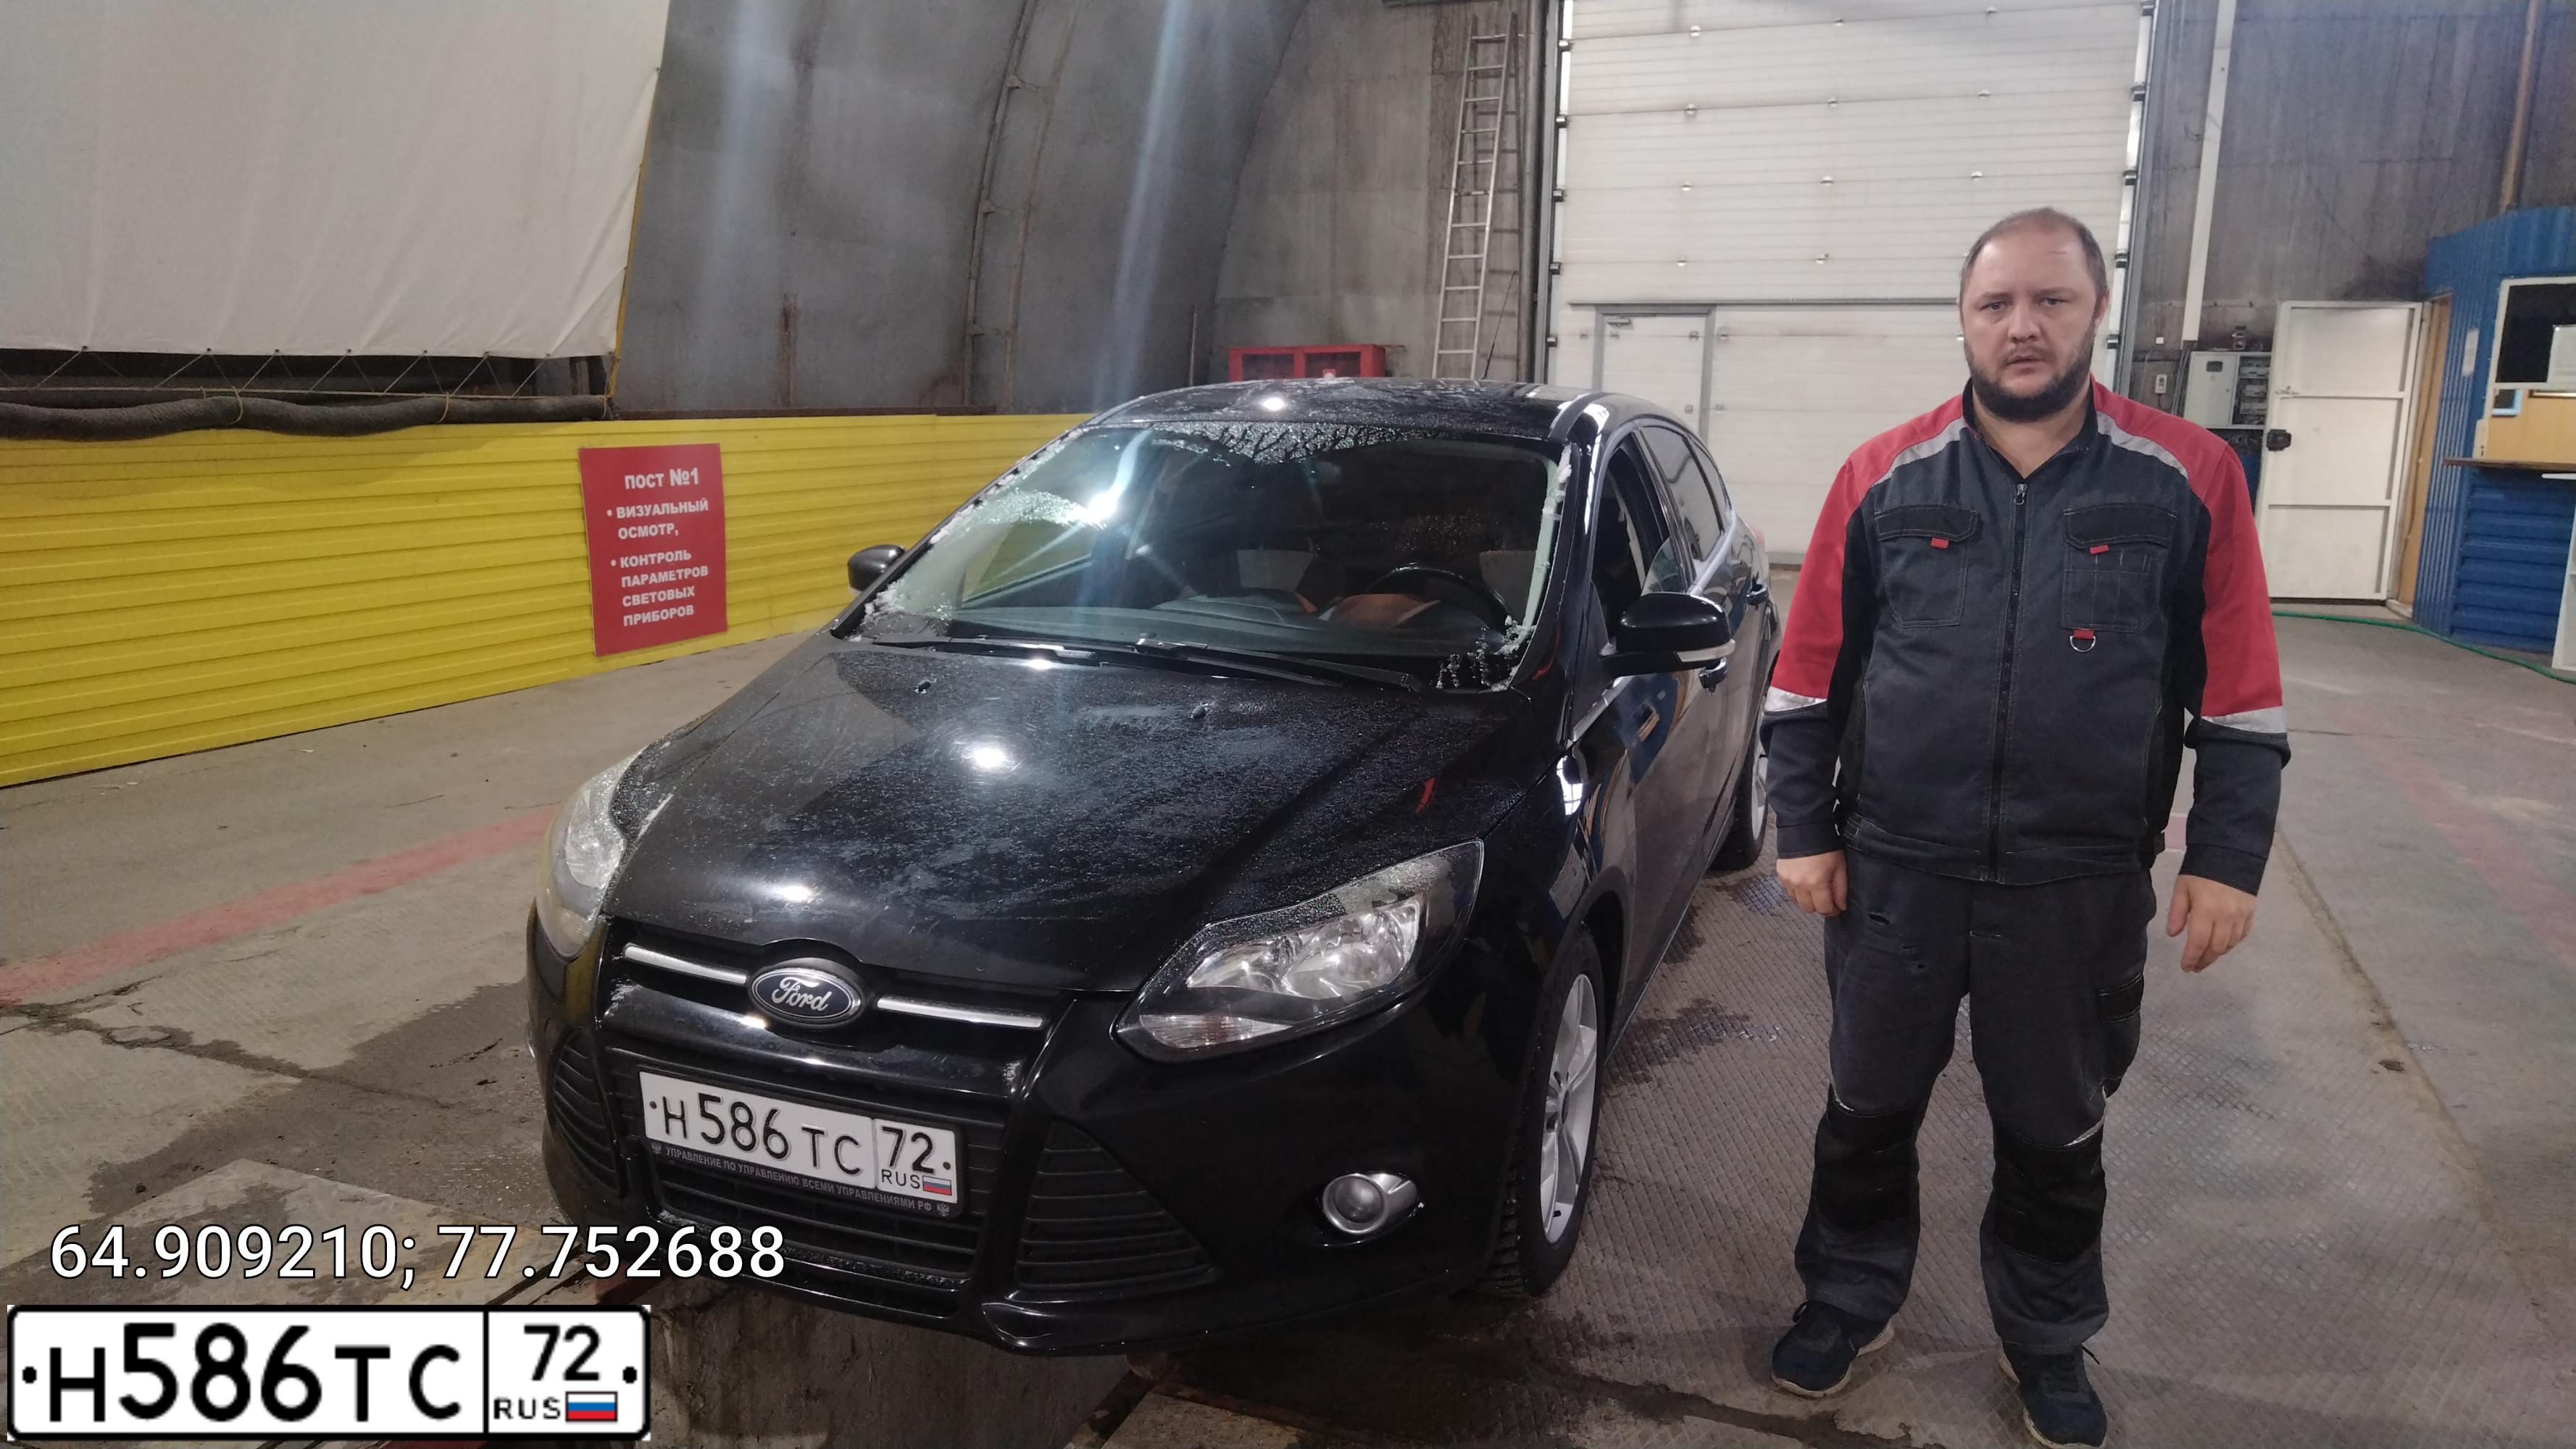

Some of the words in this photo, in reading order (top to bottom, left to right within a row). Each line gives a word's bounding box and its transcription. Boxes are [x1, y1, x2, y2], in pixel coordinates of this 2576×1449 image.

[625, 473, 664, 489] ПОСТ
[670, 467, 699, 486] №1
[616, 497, 709, 519] ВИЗУАЛЬНЫЙ
[618, 522, 679, 540] ОСМОТР,
[620, 549, 692, 568] КОНТРОЛЬ
[621, 565, 709, 588] ПАРАМЕТРОВ
[622, 585, 696, 607] СВЕТОВЫХ
[623, 605, 695, 627] ПРИБОРОВ
[771, 977, 833, 1011] Ford
[880, 1126, 934, 1174] 72
[666, 1146, 722, 1169] УПРАВЛЕНИЕ
[724, 1160, 737, 1172] ПО
[738, 1164, 800, 1186] УПРАВЛЕНИЮ
[801, 1178, 834, 1193] ВСЕМИ
[837, 1185, 916, 1209] УПРАВЛЕНИЯМИ
[917, 1202, 932, 1212] РФ
[881, 1169, 921, 1189] RUS
